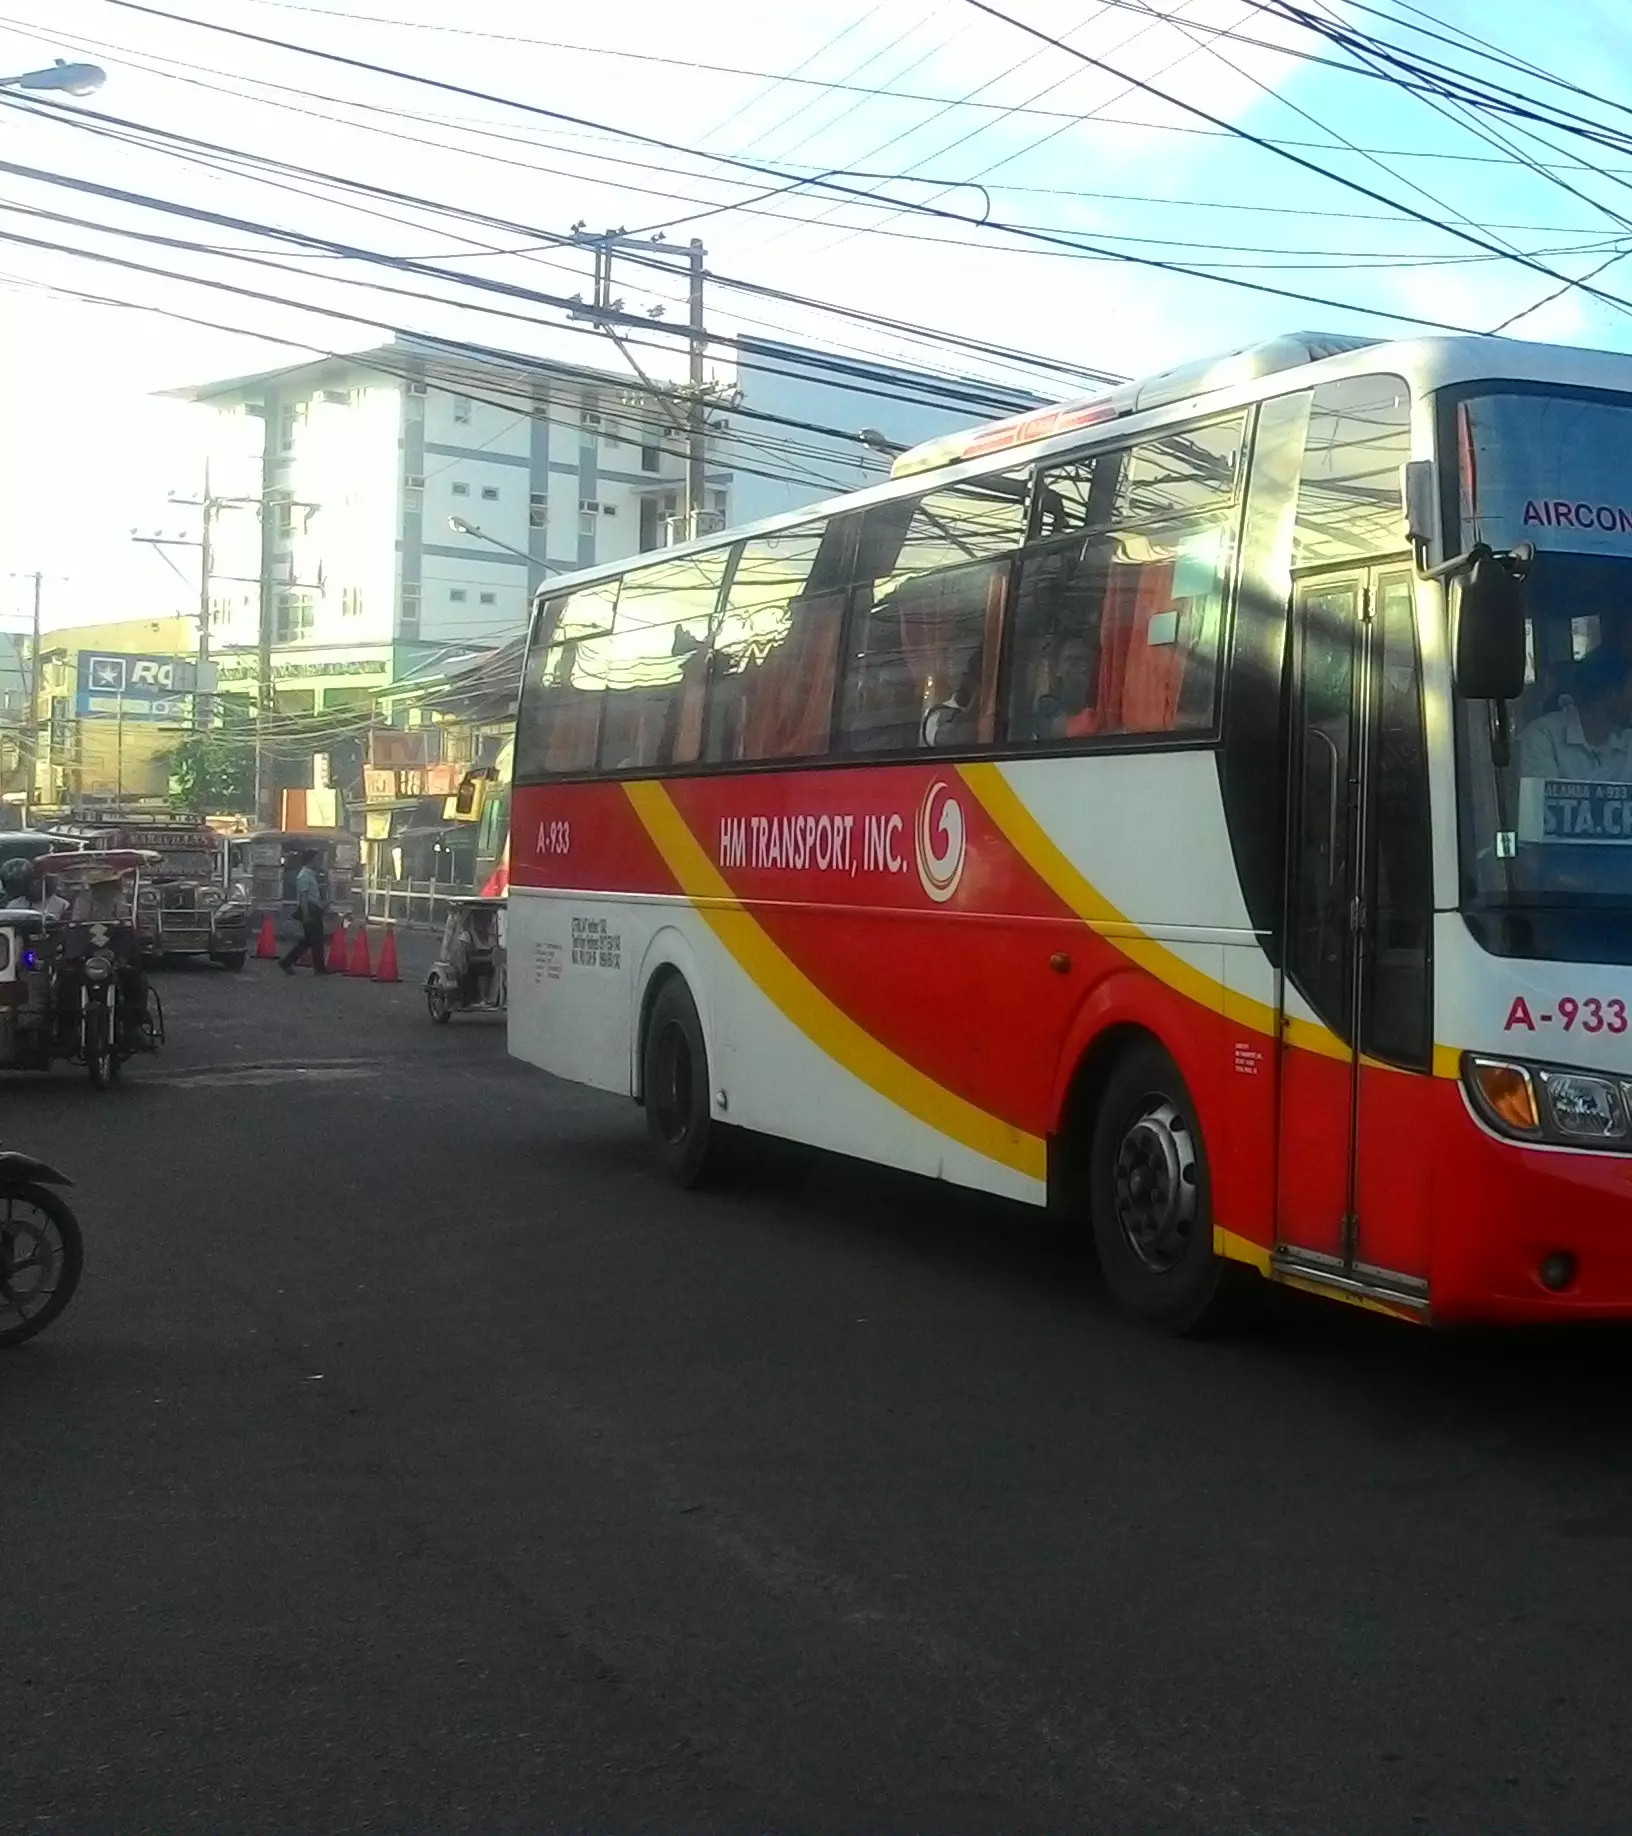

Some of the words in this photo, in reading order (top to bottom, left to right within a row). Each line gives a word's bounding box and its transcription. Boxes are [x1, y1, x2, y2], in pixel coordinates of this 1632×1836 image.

[1595, 785, 1628, 799] A-933
[535, 821, 571, 854] A-933
[719, 817, 747, 868] HM
[750, 814, 858, 878] TRANSPORT,
[863, 813, 909, 873] INC.
[1503, 996, 1629, 1034] A-933
